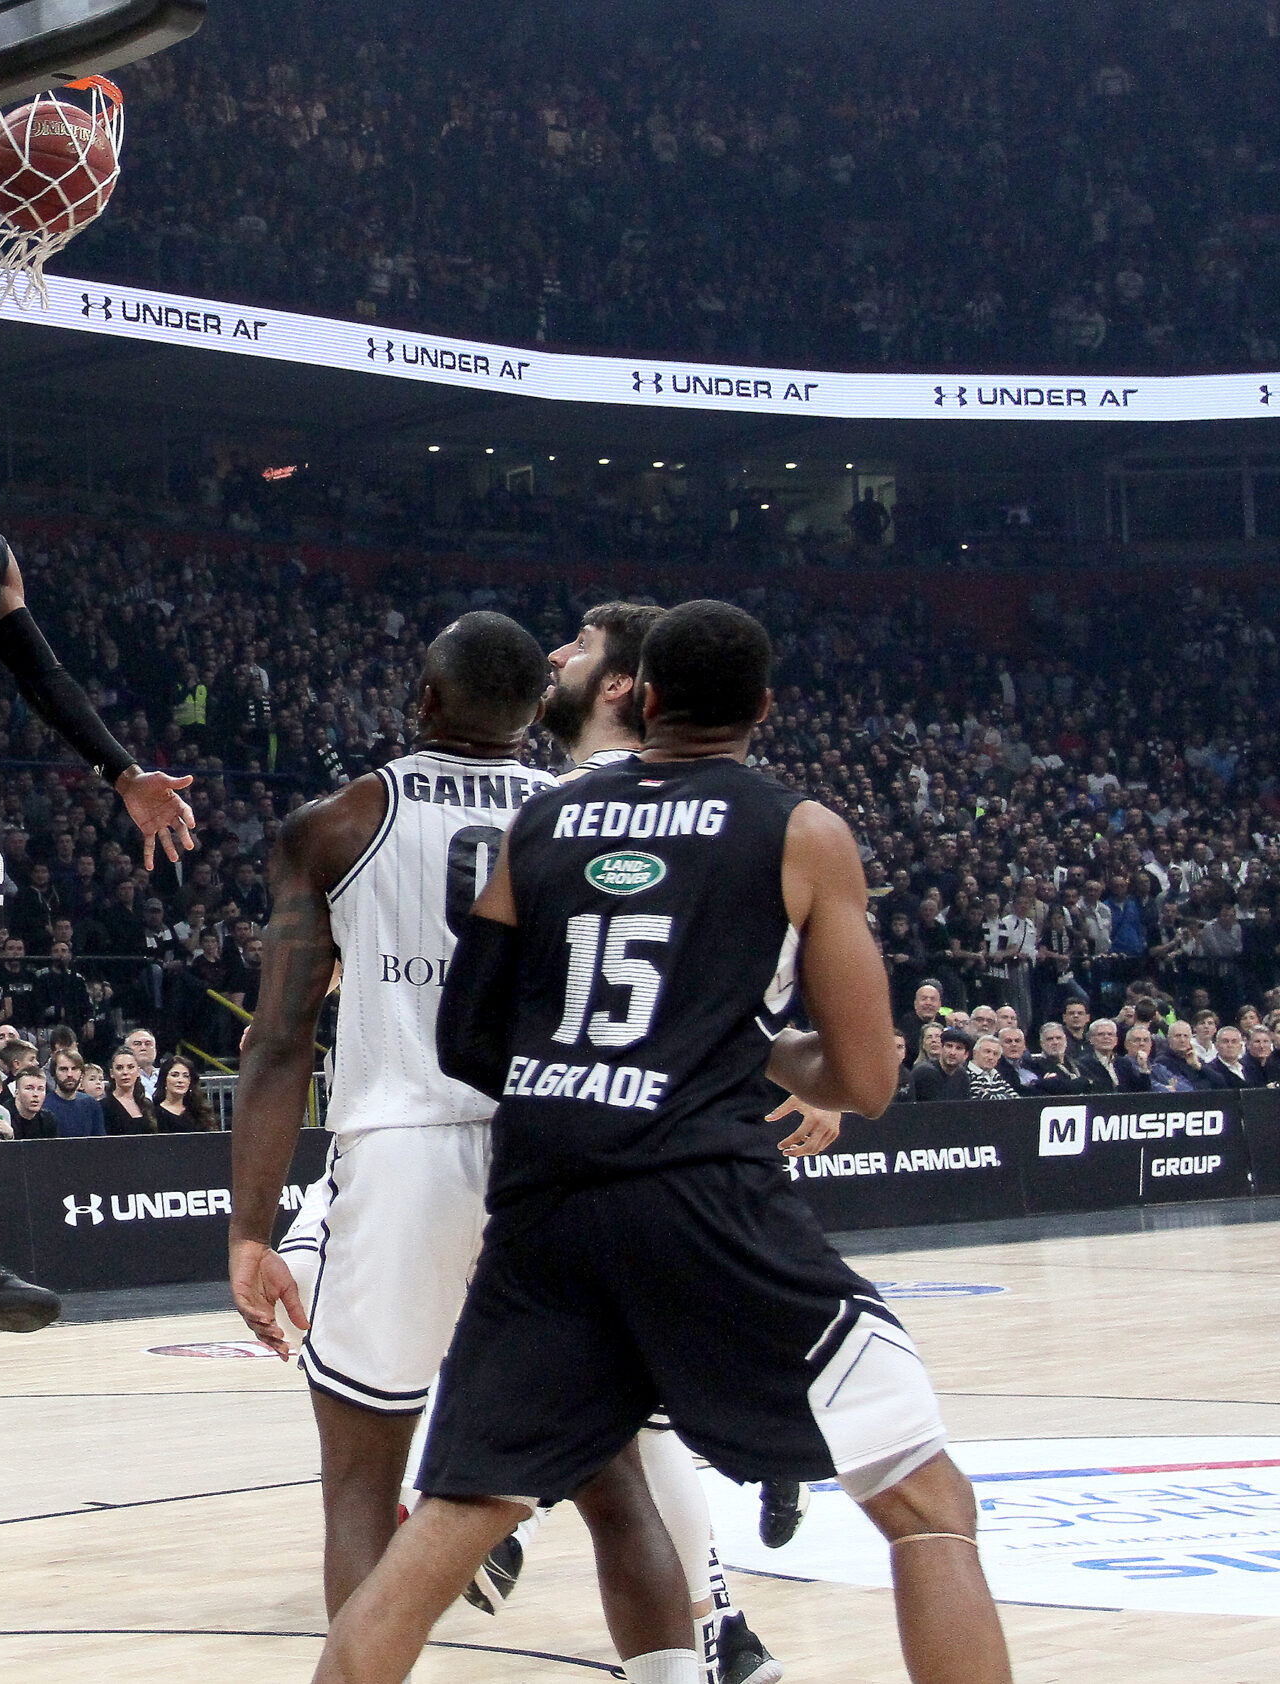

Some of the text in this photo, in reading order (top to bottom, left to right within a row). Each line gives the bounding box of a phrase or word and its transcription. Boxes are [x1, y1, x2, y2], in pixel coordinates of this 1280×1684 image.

[122, 301, 221, 335] UNDER
[402, 344, 490, 376] UNDER
[672, 375, 773, 399] UNDER
[977, 387, 1087, 407] UNDER
[553, 799, 728, 839] REDDING
[602, 859, 645, 872] LAND
[604, 872, 651, 885] ROVER
[551, 913, 672, 1047] 15
[503, 1055, 669, 1111] ELGRADE
[1092, 1110, 1224, 1142] MILSPED
[803, 1146, 998, 1178] UNDER ARMOUR
[1151, 1155, 1221, 1177] GROUP
[111, 1188, 232, 1221] UNDER
